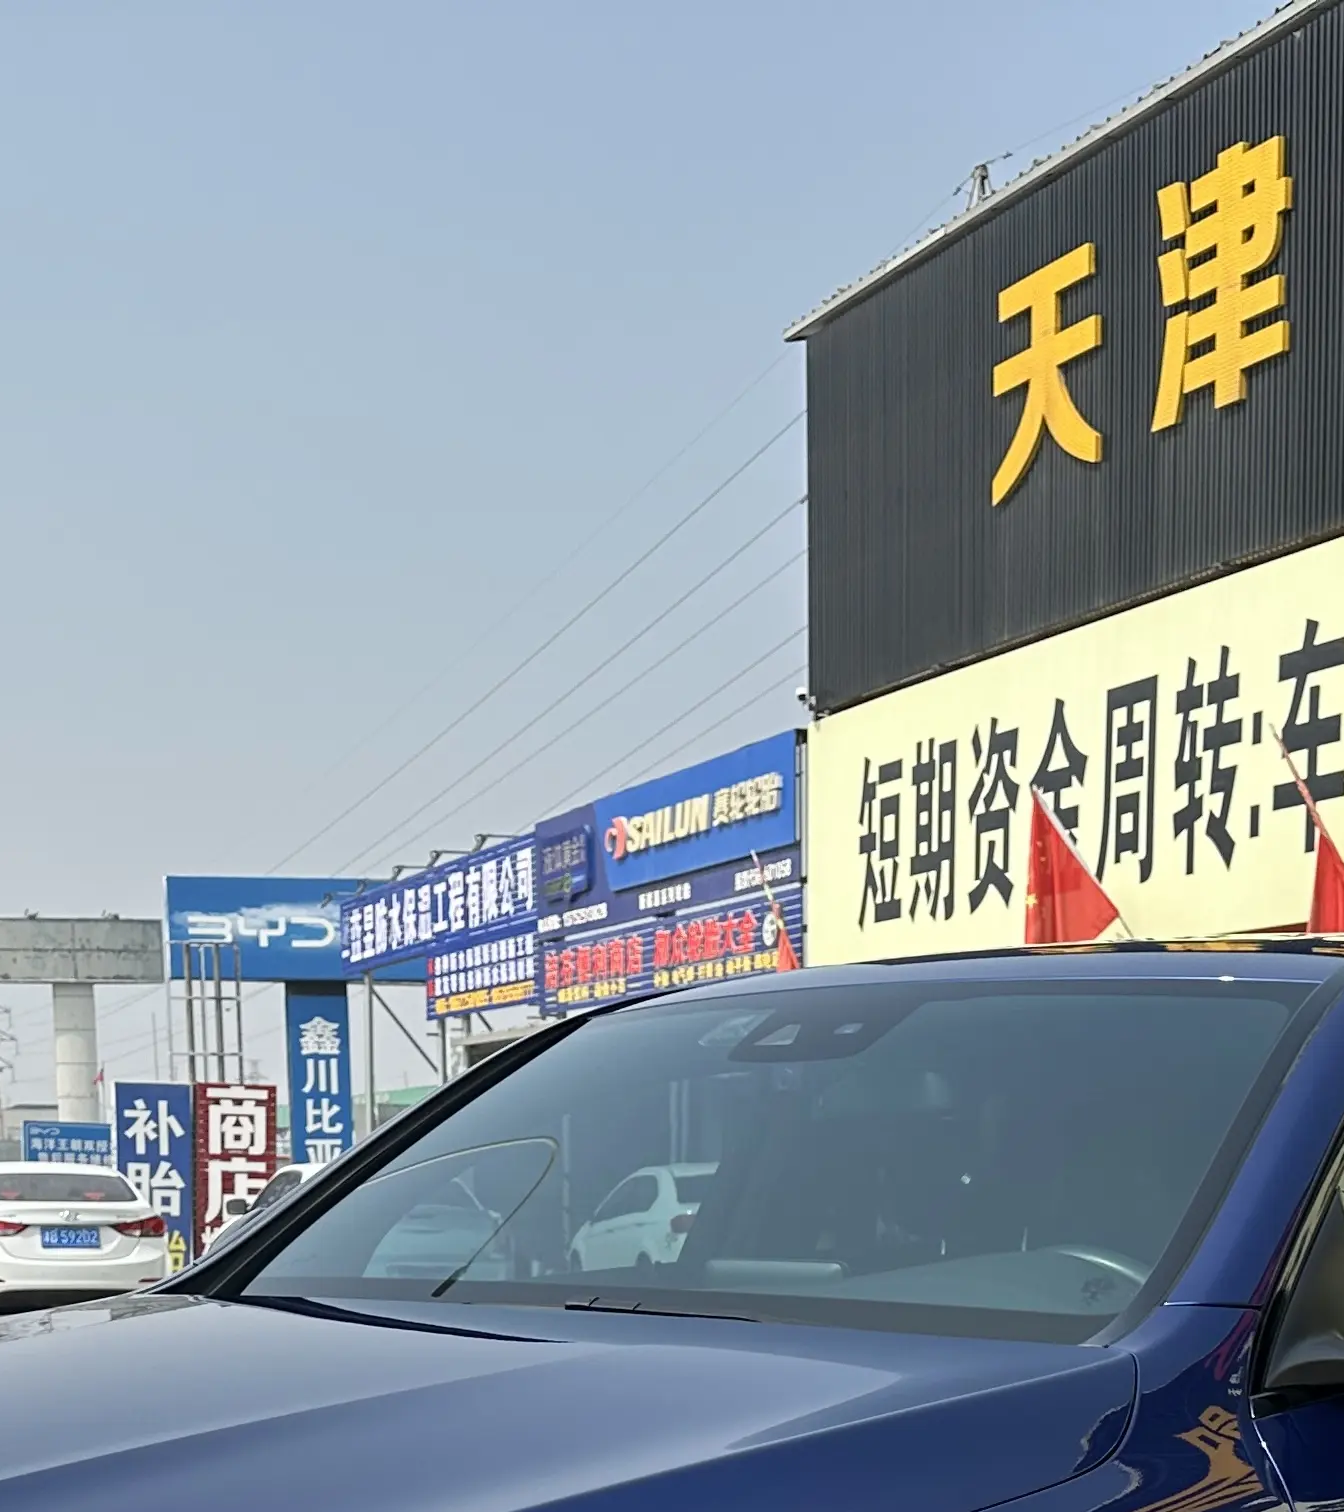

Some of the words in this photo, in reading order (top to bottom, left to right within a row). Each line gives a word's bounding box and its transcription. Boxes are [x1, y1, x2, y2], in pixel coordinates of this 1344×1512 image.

[626, 793, 712, 852] SAILUN
[187, 916, 335, 948] BYD
[123, 1098, 186, 1217] 补胎
